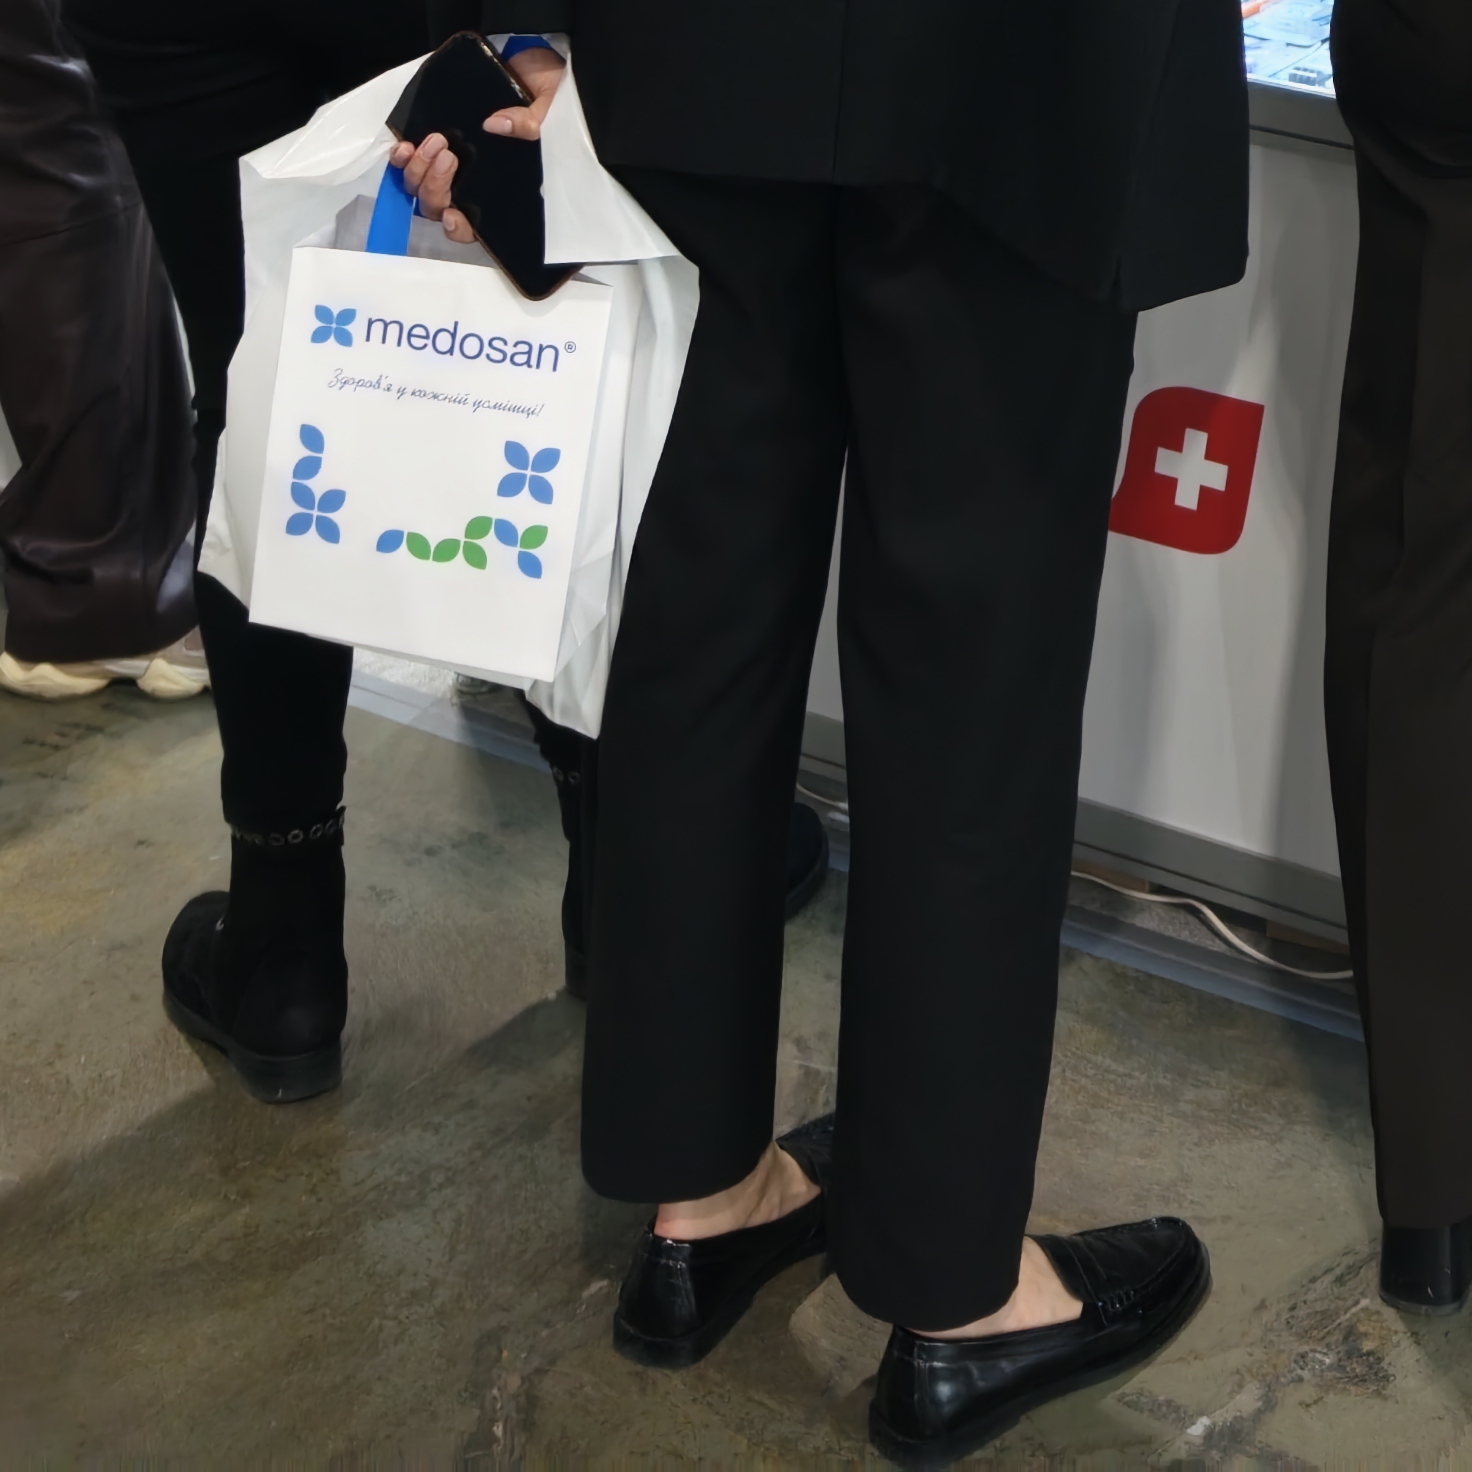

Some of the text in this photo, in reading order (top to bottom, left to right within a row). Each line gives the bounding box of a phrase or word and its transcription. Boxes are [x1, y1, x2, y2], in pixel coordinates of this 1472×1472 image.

[328, 368, 545, 419] Здоров'я у кожній усмішці!
